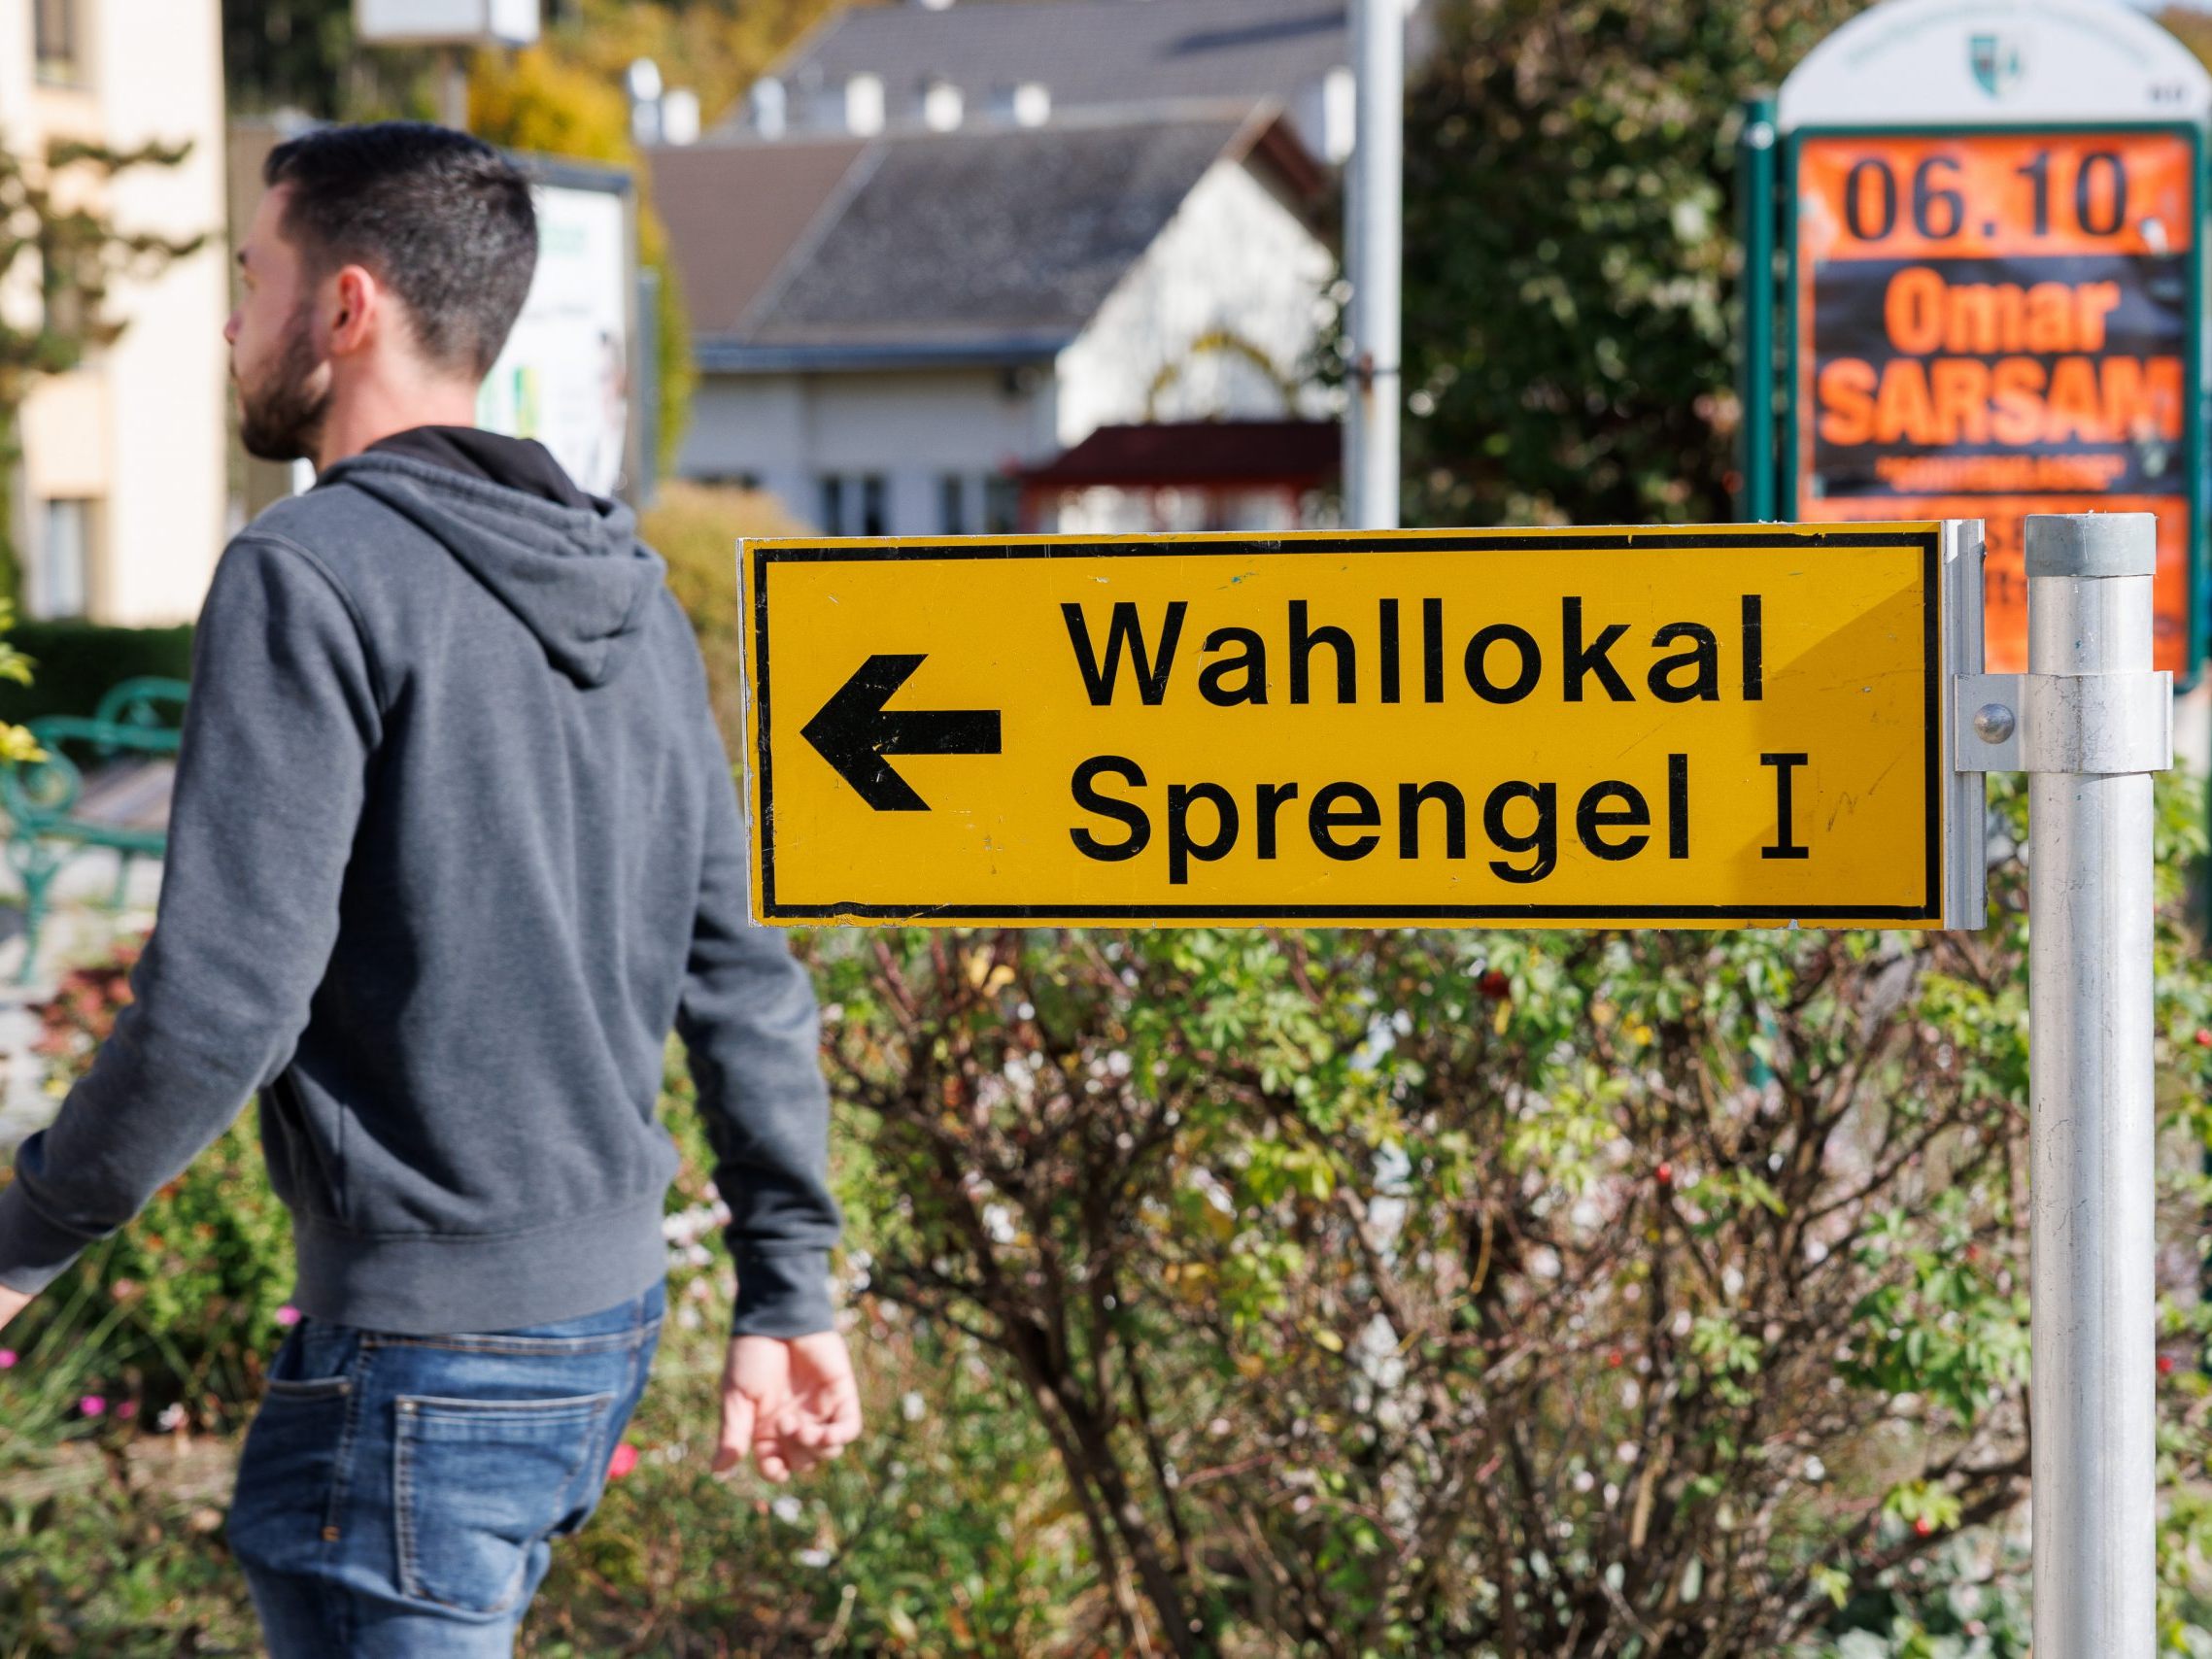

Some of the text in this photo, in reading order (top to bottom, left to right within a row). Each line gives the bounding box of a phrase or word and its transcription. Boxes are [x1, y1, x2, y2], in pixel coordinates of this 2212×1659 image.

[1845, 150, 2127, 241] 06.10
[1884, 266, 2121, 355] Omar
[1819, 355, 2185, 446] SARSAM
[1061, 594, 1763, 707] Wahllokal
[1071, 753, 1810, 885] Sprengel I
